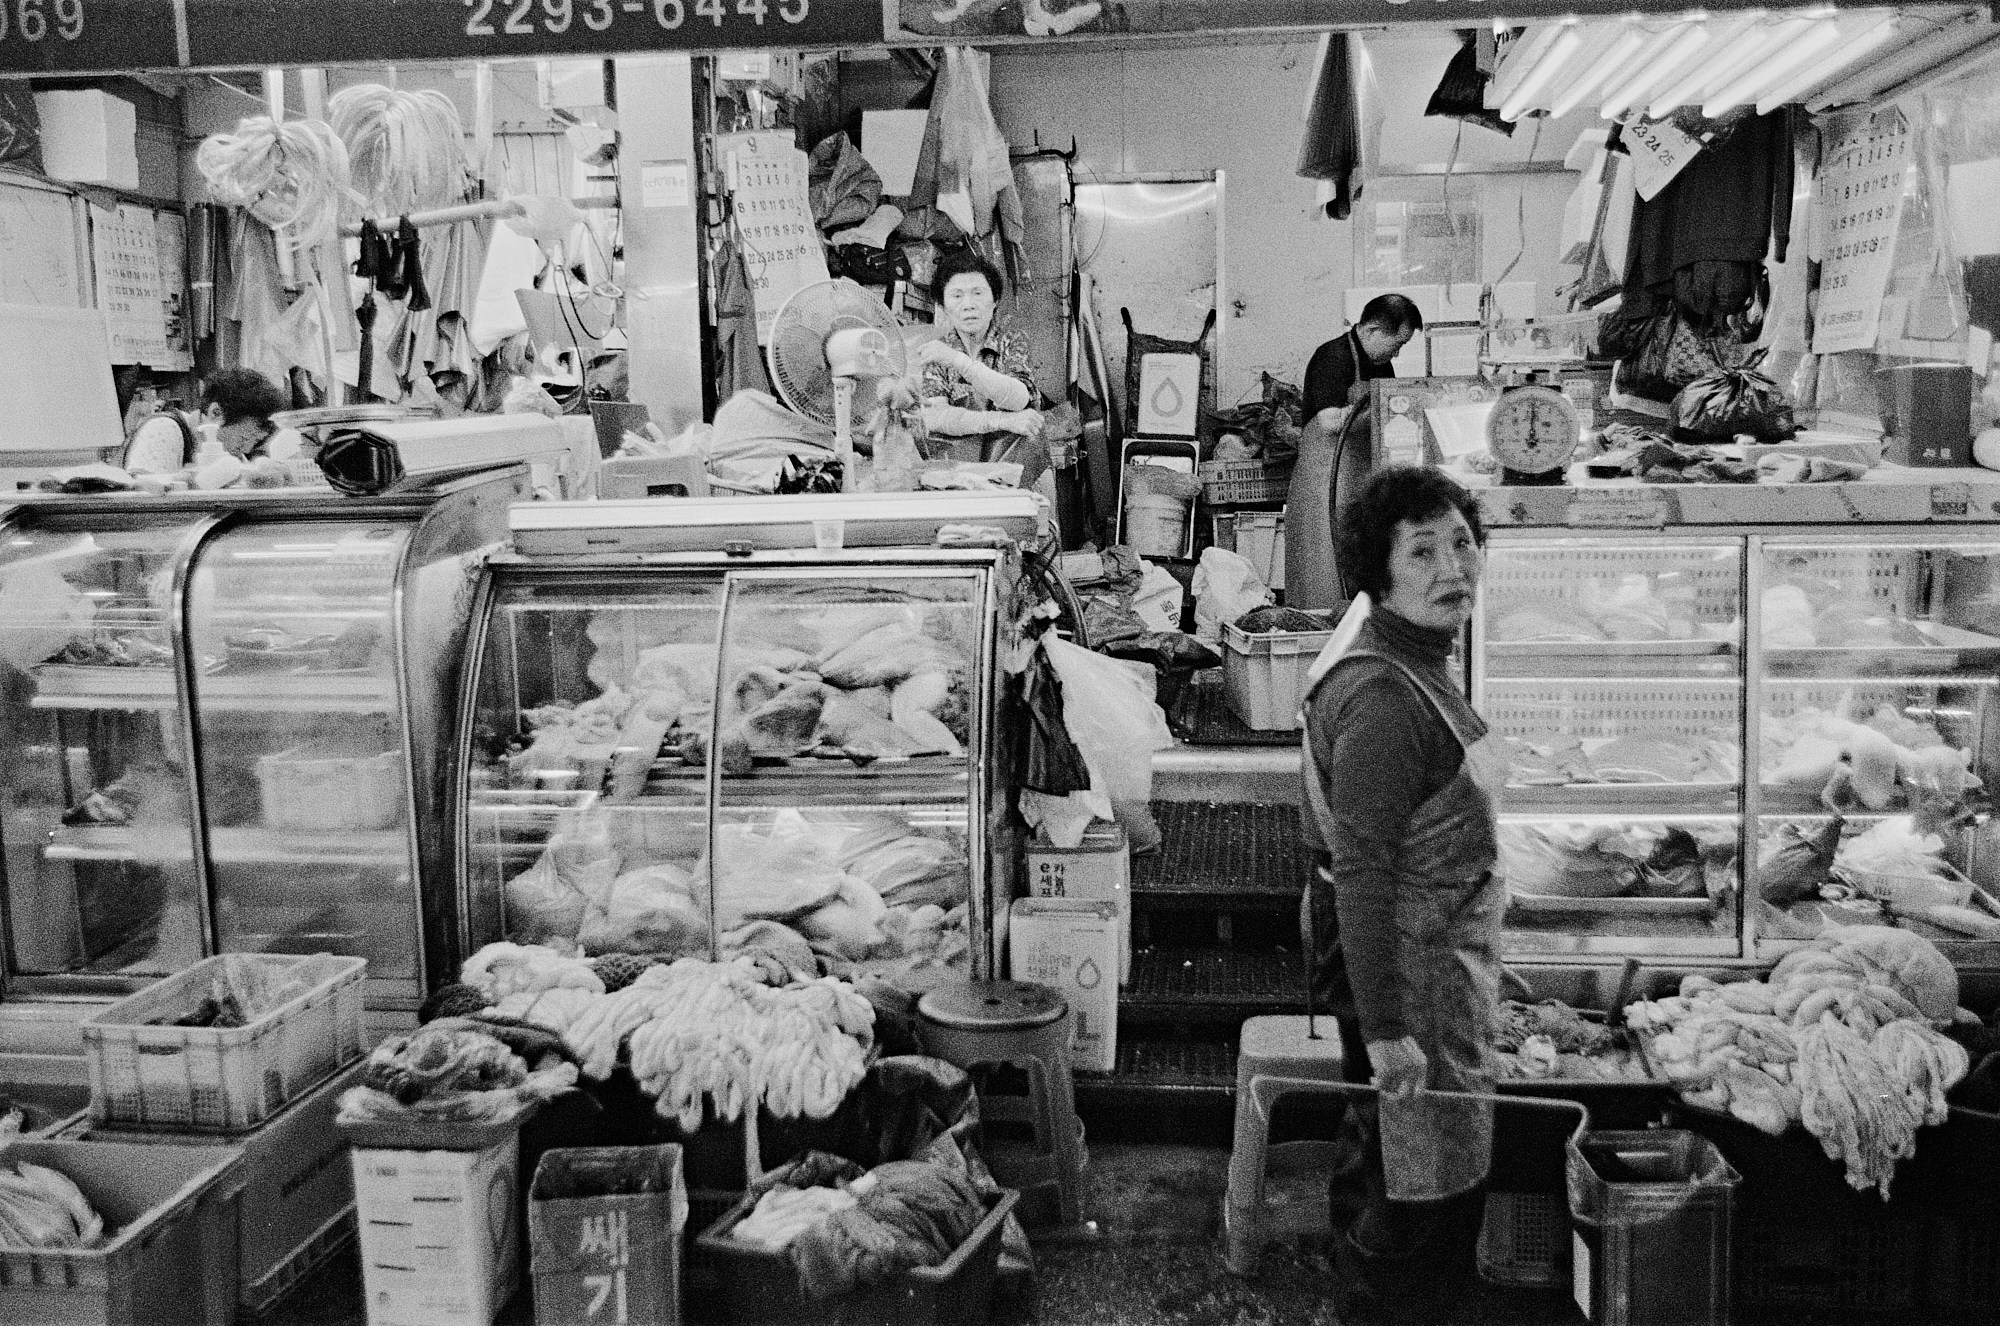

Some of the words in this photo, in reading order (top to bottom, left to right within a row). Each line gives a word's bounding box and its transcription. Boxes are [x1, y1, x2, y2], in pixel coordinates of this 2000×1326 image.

[0, 0, 83, 41] 69
[466, 0, 810, 35] 2293-6445
[747, 136, 758, 154] 9
[1631, 121, 1648, 138] 23
[1644, 135, 1662, 152] 24
[1658, 149, 1675, 167] 25
[746, 175, 753, 187] 2
